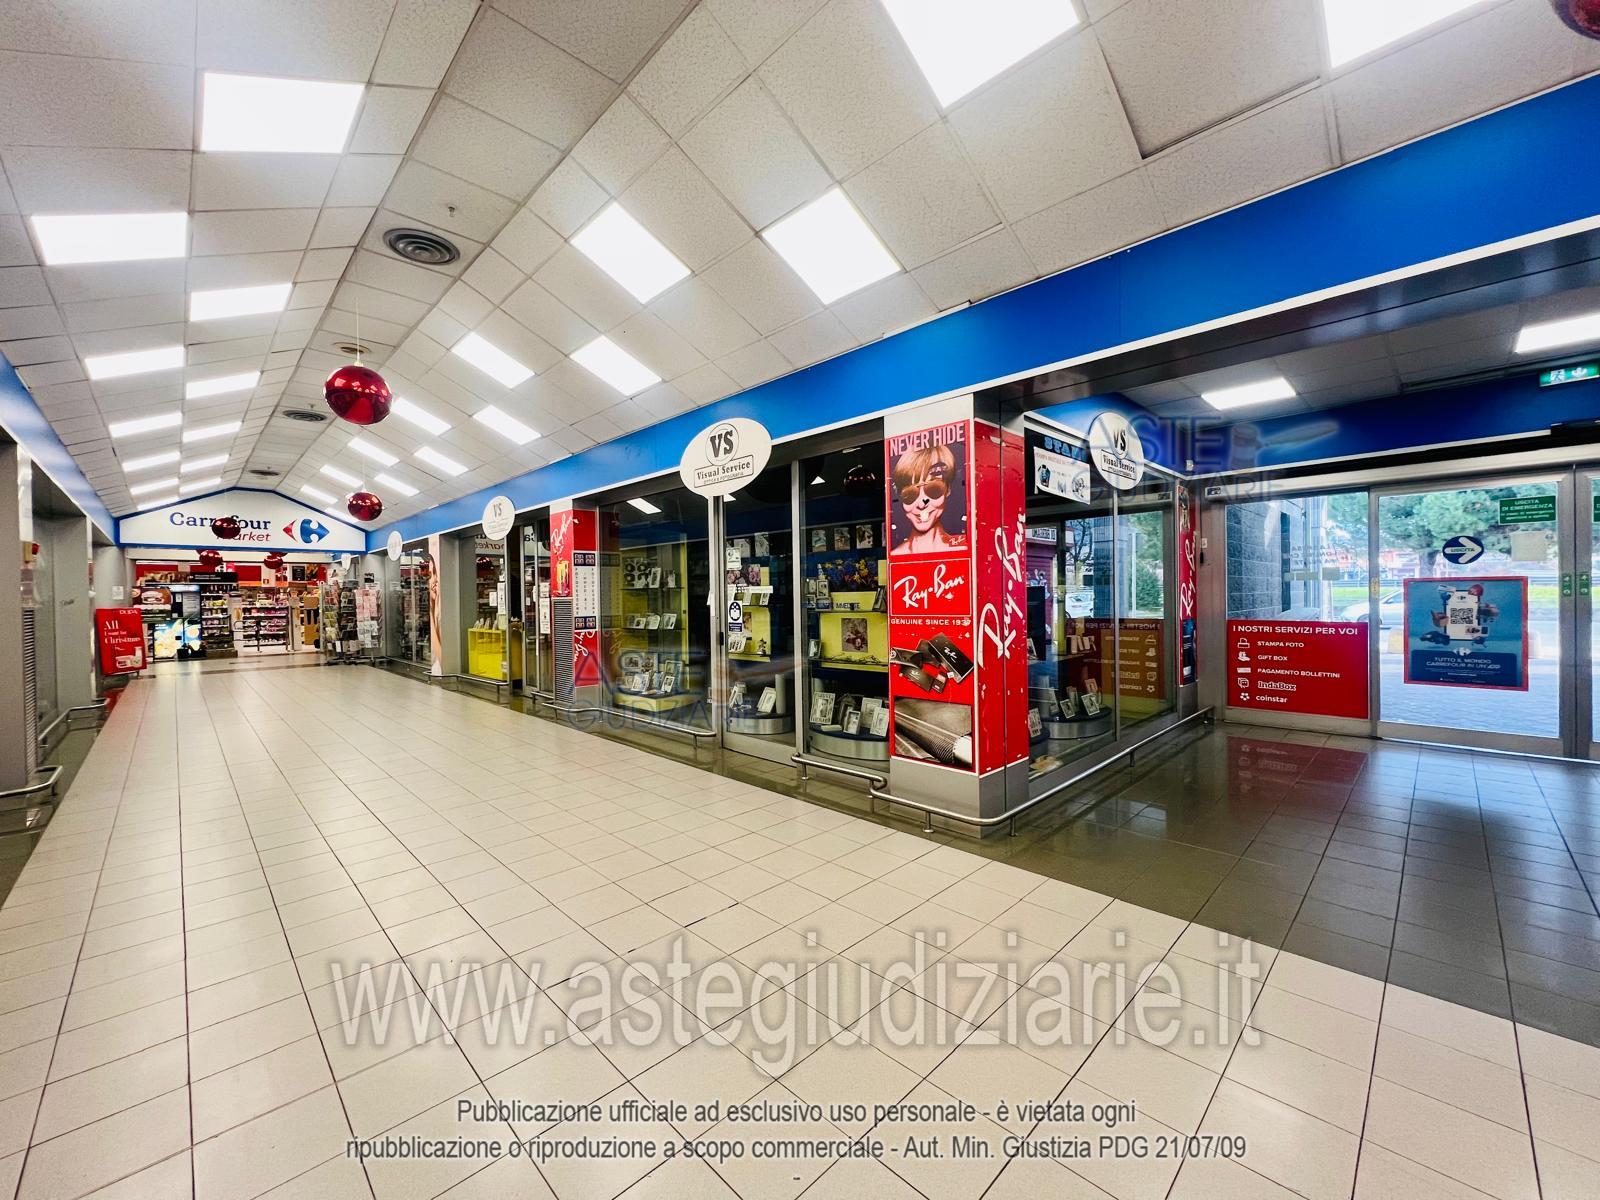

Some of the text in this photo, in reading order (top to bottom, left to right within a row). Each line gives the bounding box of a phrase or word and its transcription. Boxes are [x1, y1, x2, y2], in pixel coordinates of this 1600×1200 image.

[710, 430, 733, 458] VS
[889, 423, 965, 457] NEVER HIDE
[1113, 429, 1126, 451] VS
[697, 461, 751, 480] Visual Service
[1510, 503, 1553, 511] EMERGENZA
[169, 512, 271, 529] Carrour
[217, 531, 271, 541] arket
[104, 620, 119, 630] All
[1275, 626, 1313, 634] SERVIZI
[1315, 627, 1336, 635] PER
[104, 636, 141, 644] Christmas
[1257, 668, 1340, 678] PAGAMENTO BOLLETTINI
[1257, 680, 1297, 692] IndaBox
[1255, 694, 1288, 703] coinstar
